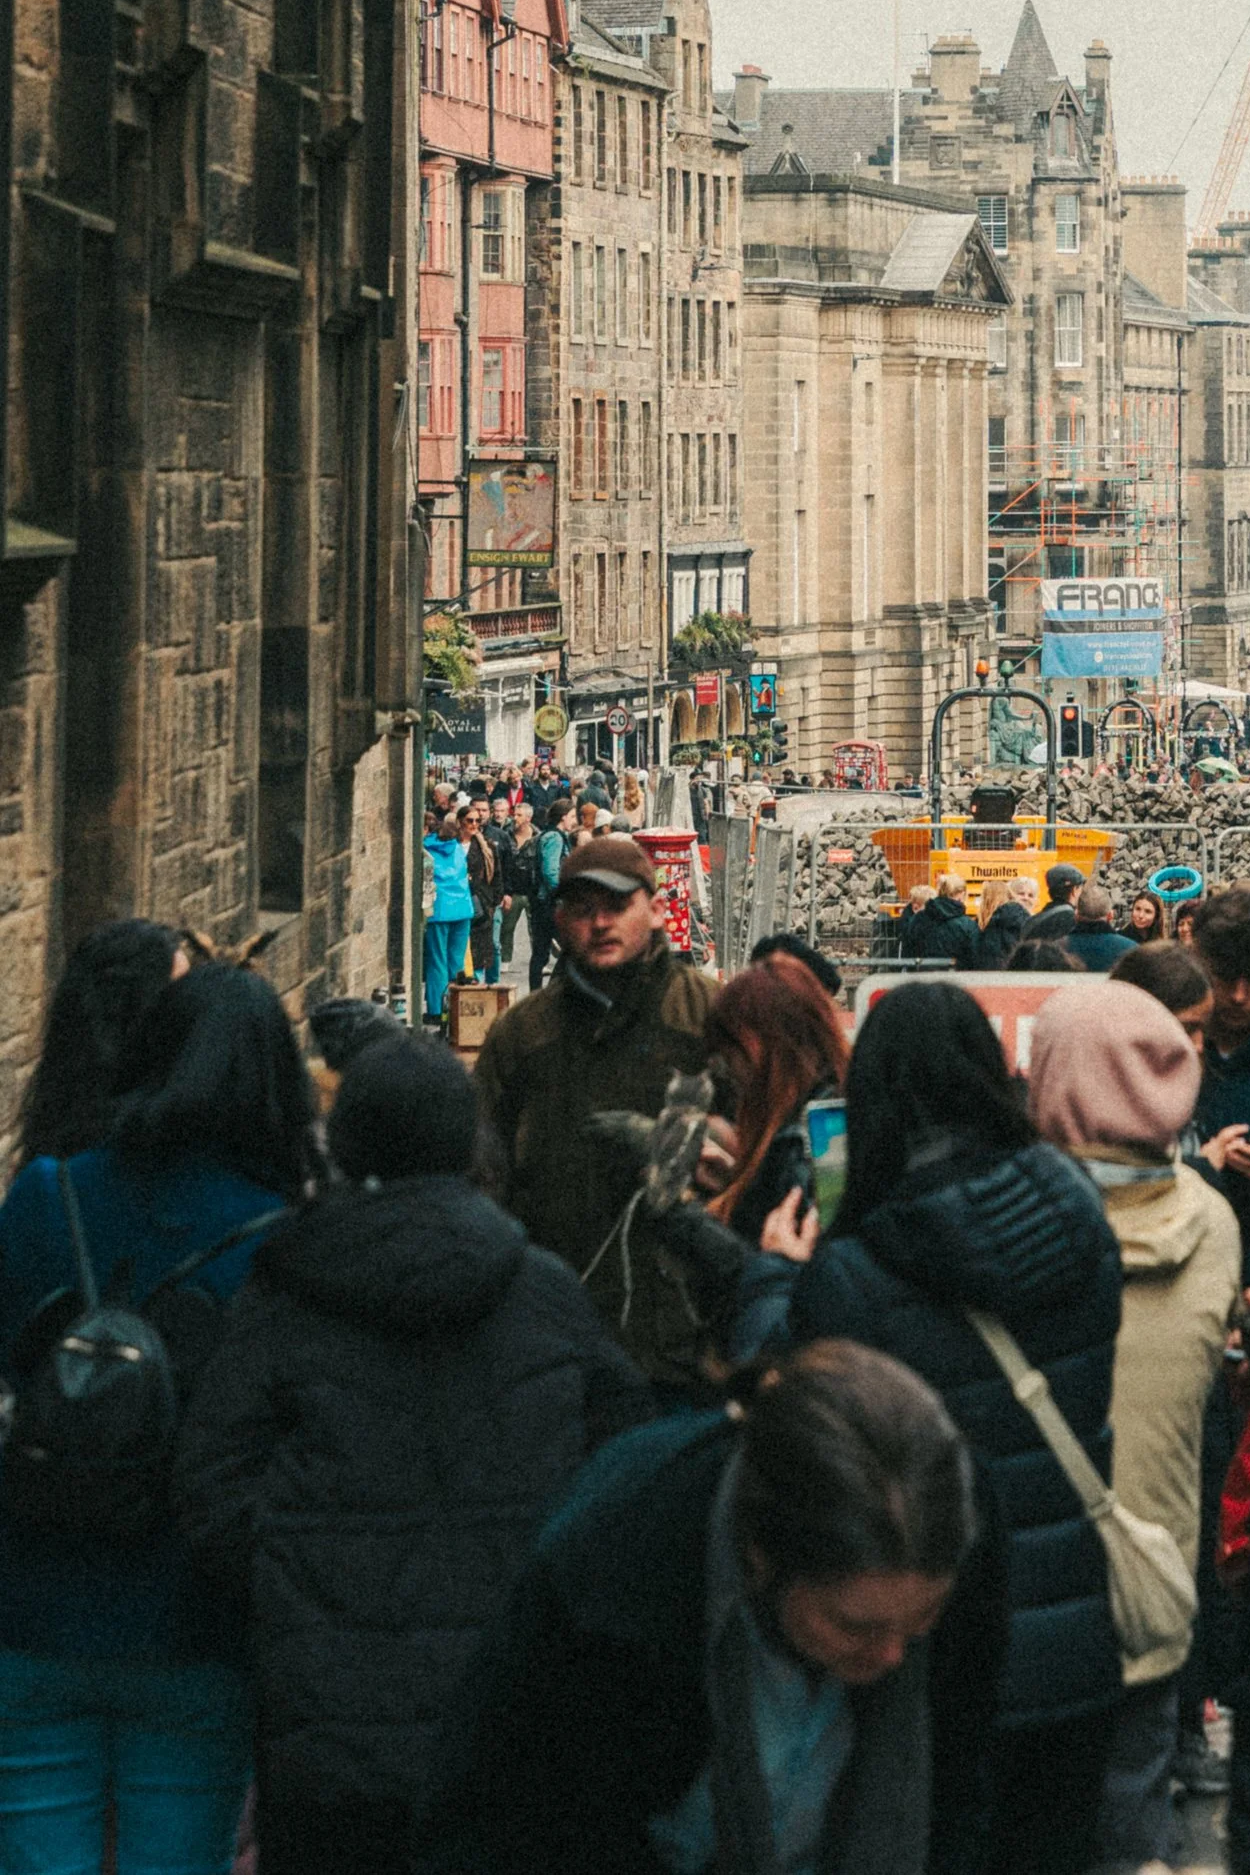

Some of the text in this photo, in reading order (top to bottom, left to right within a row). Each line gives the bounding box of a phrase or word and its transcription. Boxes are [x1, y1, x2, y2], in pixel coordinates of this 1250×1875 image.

[469, 552, 550, 563] ENSIGN EWART
[610, 714, 626, 726] 20
[971, 866, 1018, 877] Thwaites
